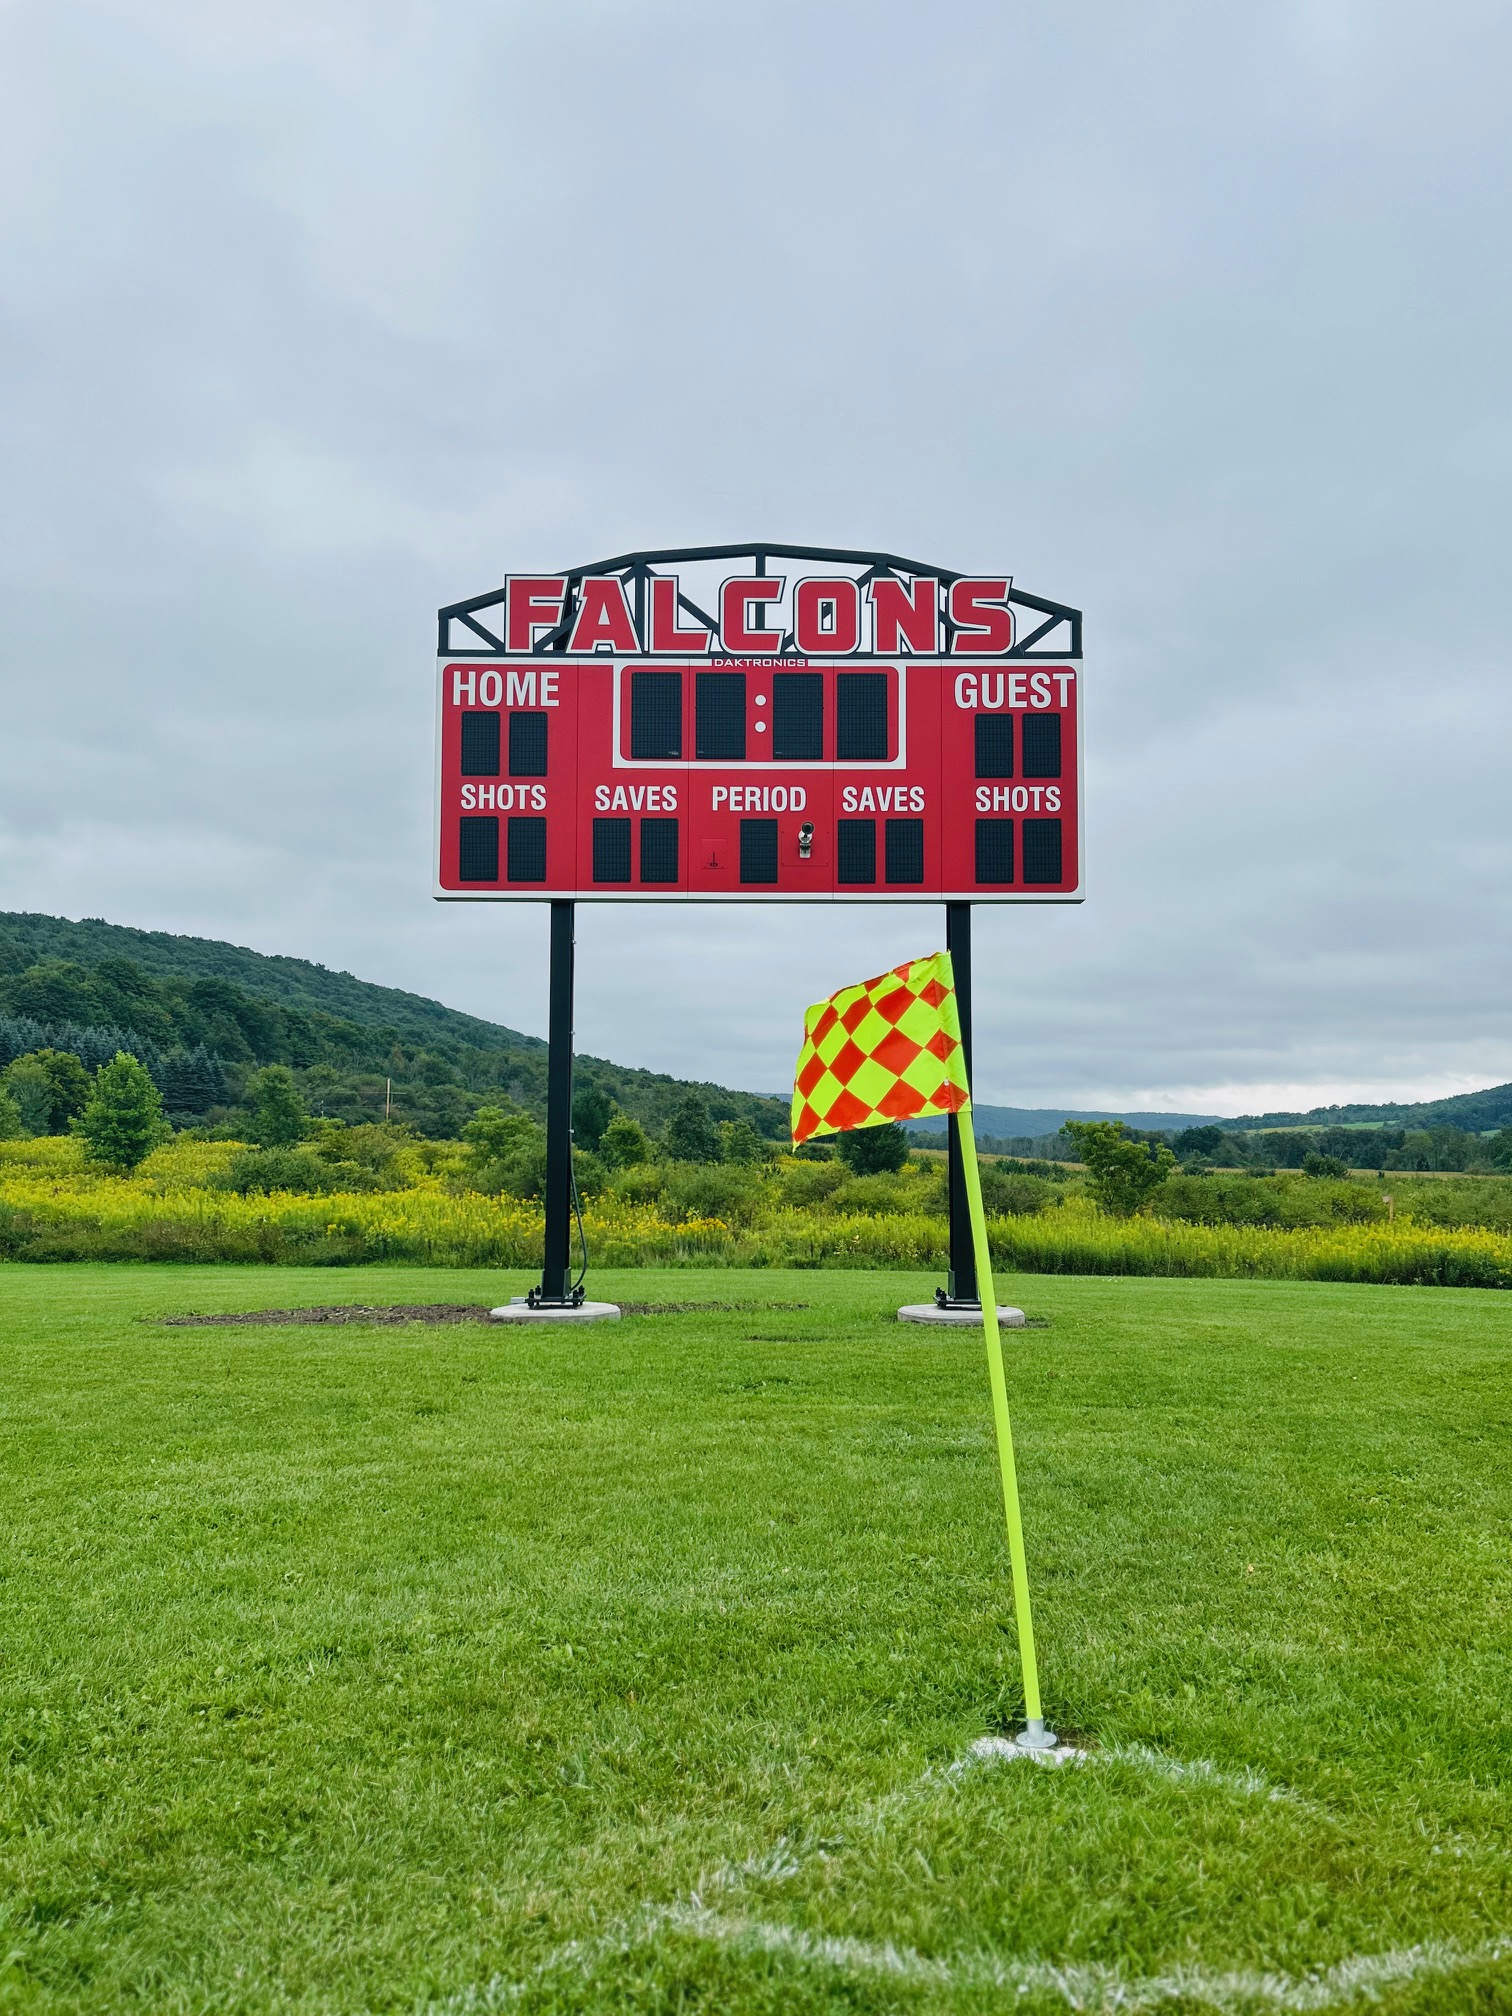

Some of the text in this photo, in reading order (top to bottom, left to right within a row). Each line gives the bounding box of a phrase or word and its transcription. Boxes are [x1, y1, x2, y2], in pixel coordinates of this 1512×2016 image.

[504, 574, 1016, 655] FALCONS
[714, 659, 806, 667] DAKTRONICS
[452, 671, 560, 707] HOME
[954, 672, 1075, 709] GUEST
[460, 784, 547, 811] SHOTS
[595, 785, 678, 811] SAVES
[712, 786, 807, 812] PERIOD
[842, 786, 925, 812] SAVES
[975, 786, 1062, 812] SHOTS
